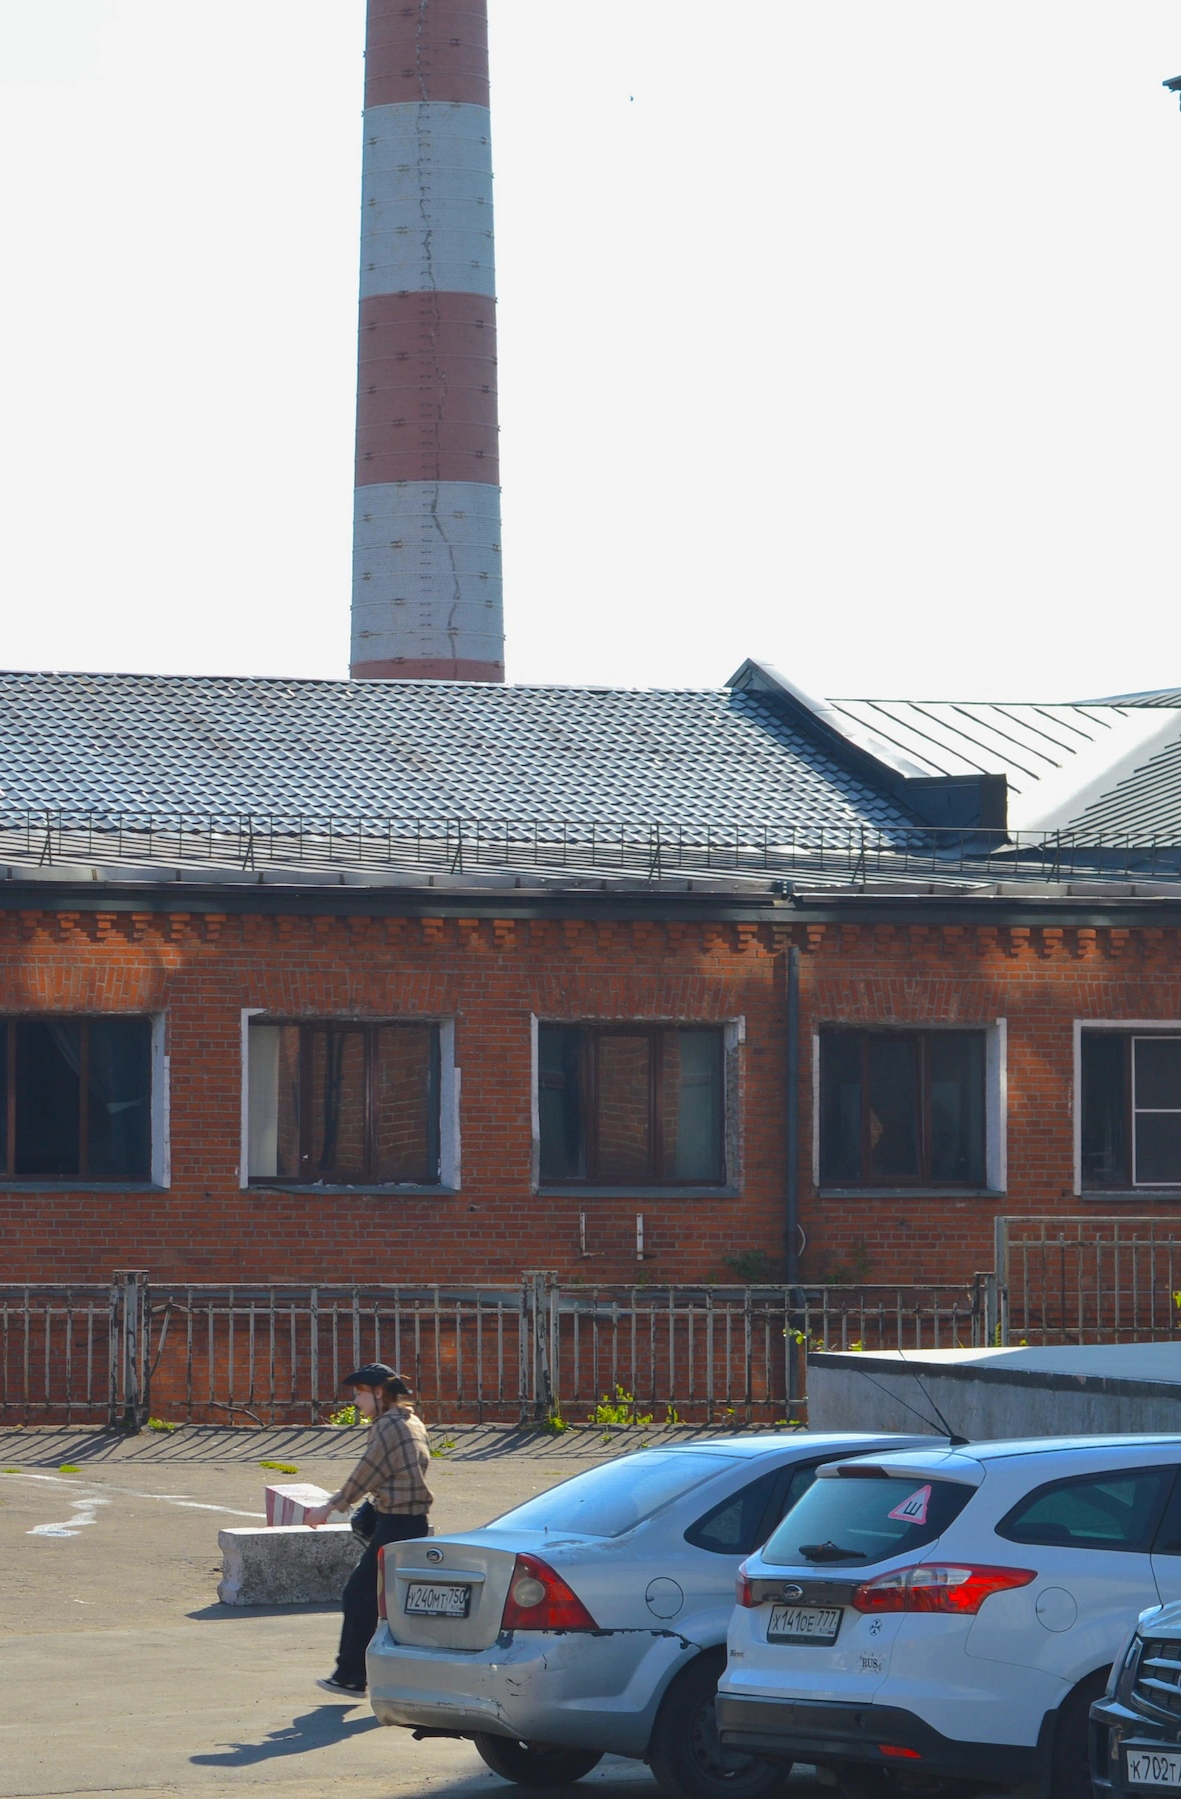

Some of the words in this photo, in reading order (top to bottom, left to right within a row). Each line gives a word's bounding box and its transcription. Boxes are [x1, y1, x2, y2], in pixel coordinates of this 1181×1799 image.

[903, 1501, 923, 1516] Ш
[862, 1657, 878, 1669] RUS
[1132, 1755, 1181, 1783] К702Т
